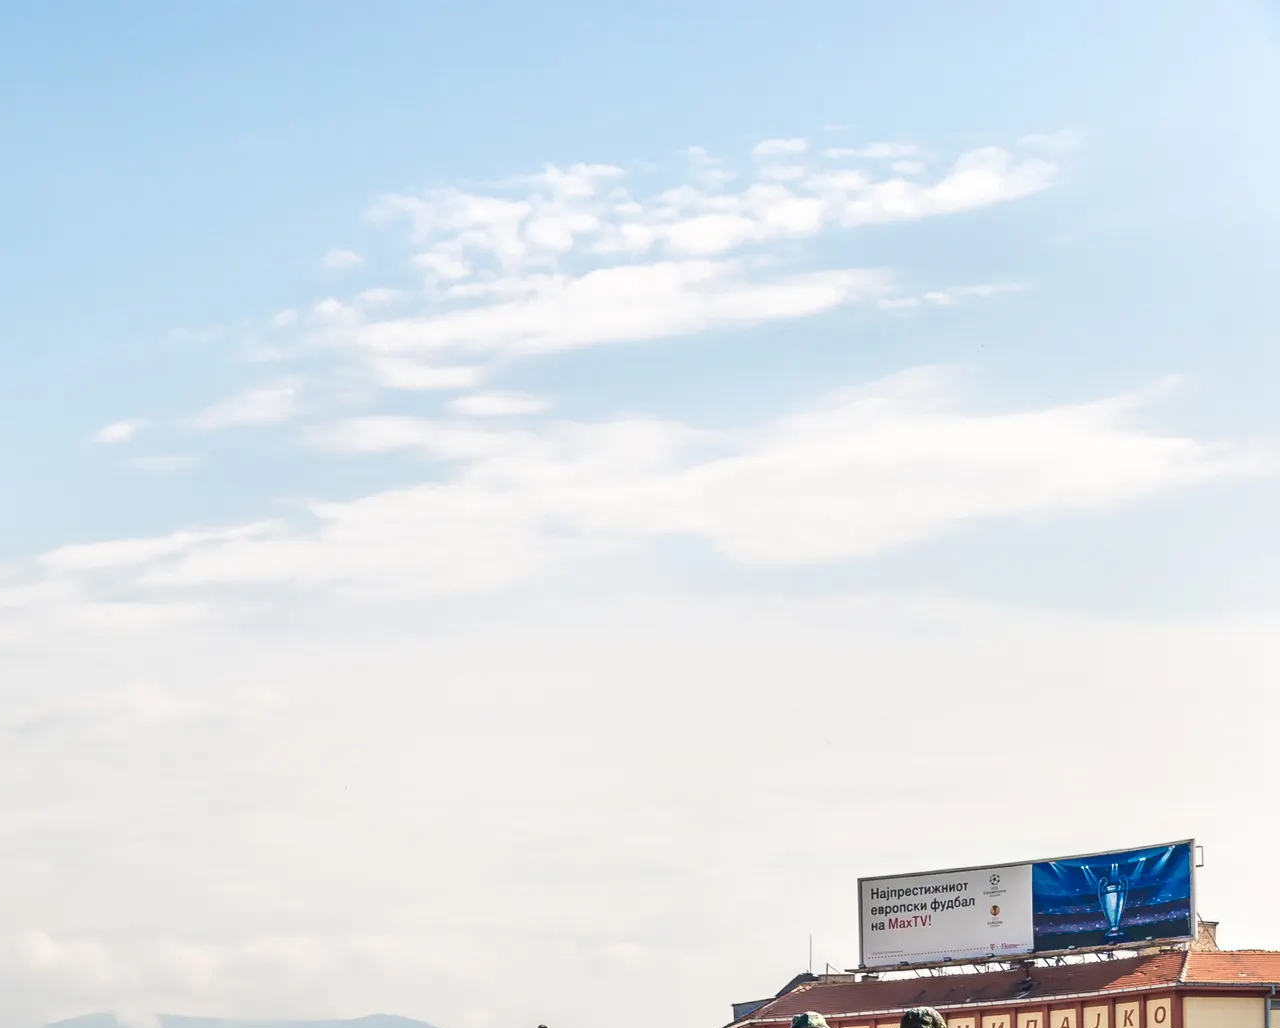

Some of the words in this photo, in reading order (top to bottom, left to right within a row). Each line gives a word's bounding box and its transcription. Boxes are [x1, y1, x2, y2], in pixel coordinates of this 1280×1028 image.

[870, 882, 969, 901] Најпрестижниот
[870, 901, 927, 917] европски
[930, 896, 976, 912] фудбал
[871, 921, 885, 931] на
[888, 915, 932, 930] MaxTV!
